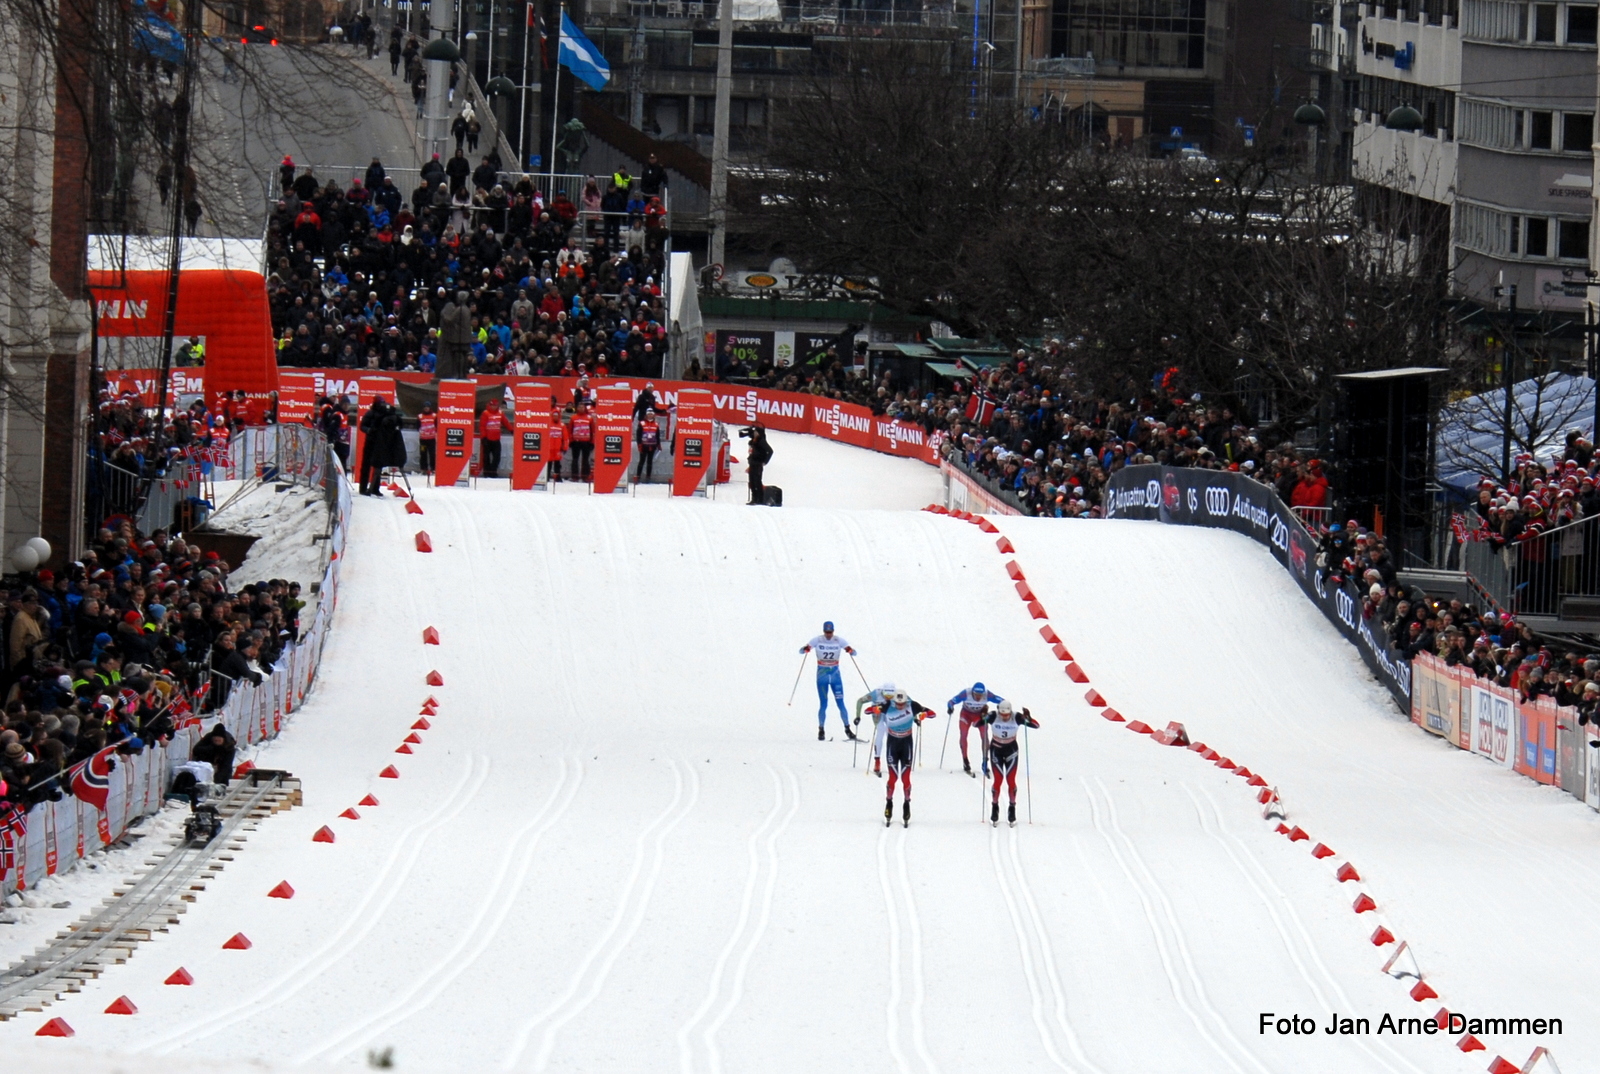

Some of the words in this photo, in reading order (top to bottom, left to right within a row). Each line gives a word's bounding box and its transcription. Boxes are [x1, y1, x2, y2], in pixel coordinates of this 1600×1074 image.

[713, 391, 804, 421] VIESSMANN
[814, 404, 870, 435] VIESSMANN
[877, 419, 923, 449] VIESSMANN
[1187, 488, 1198, 513] Q5
[1232, 493, 1250, 520] Audi
[823, 652, 834, 660] 22
